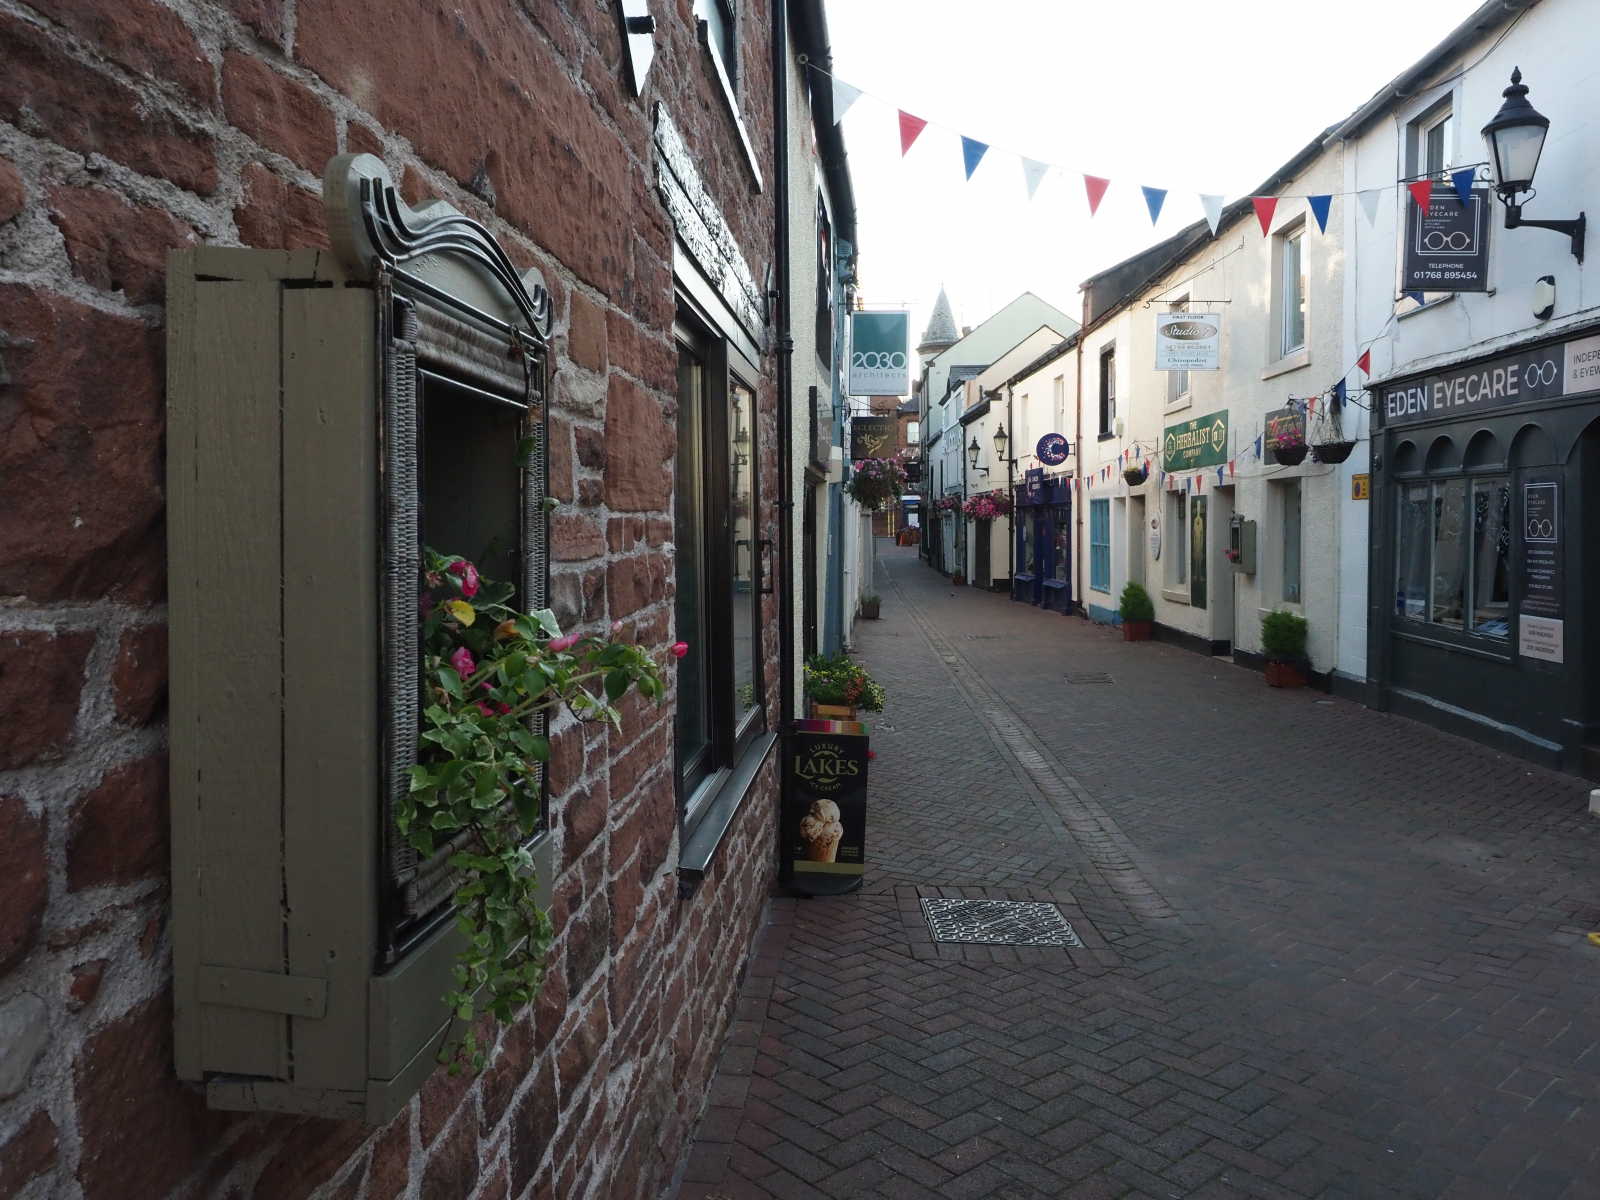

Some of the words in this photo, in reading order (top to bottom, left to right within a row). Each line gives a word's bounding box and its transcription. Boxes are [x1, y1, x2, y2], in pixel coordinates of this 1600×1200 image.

[1414, 271, 1442, 279] 01768
[1444, 271, 1477, 279] 895454
[1164, 324, 1200, 336] Studio
[1202, 326, 1211, 338] 7
[852, 351, 907, 369] 2030
[852, 371, 907, 379] architects
[1572, 369, 1578, 379] &
[1387, 385, 1428, 418] EDEN
[1433, 364, 1519, 410] EYECARE
[1189, 420, 1198, 431] THE
[1176, 427, 1211, 450] HERBALIST
[1182, 446, 1202, 459] COMPANY
[809, 743, 845, 755] LUXURY
[794, 755, 859, 779] LAKES
[809, 780, 819, 790] ICE
[819, 782, 842, 791] CREAM
